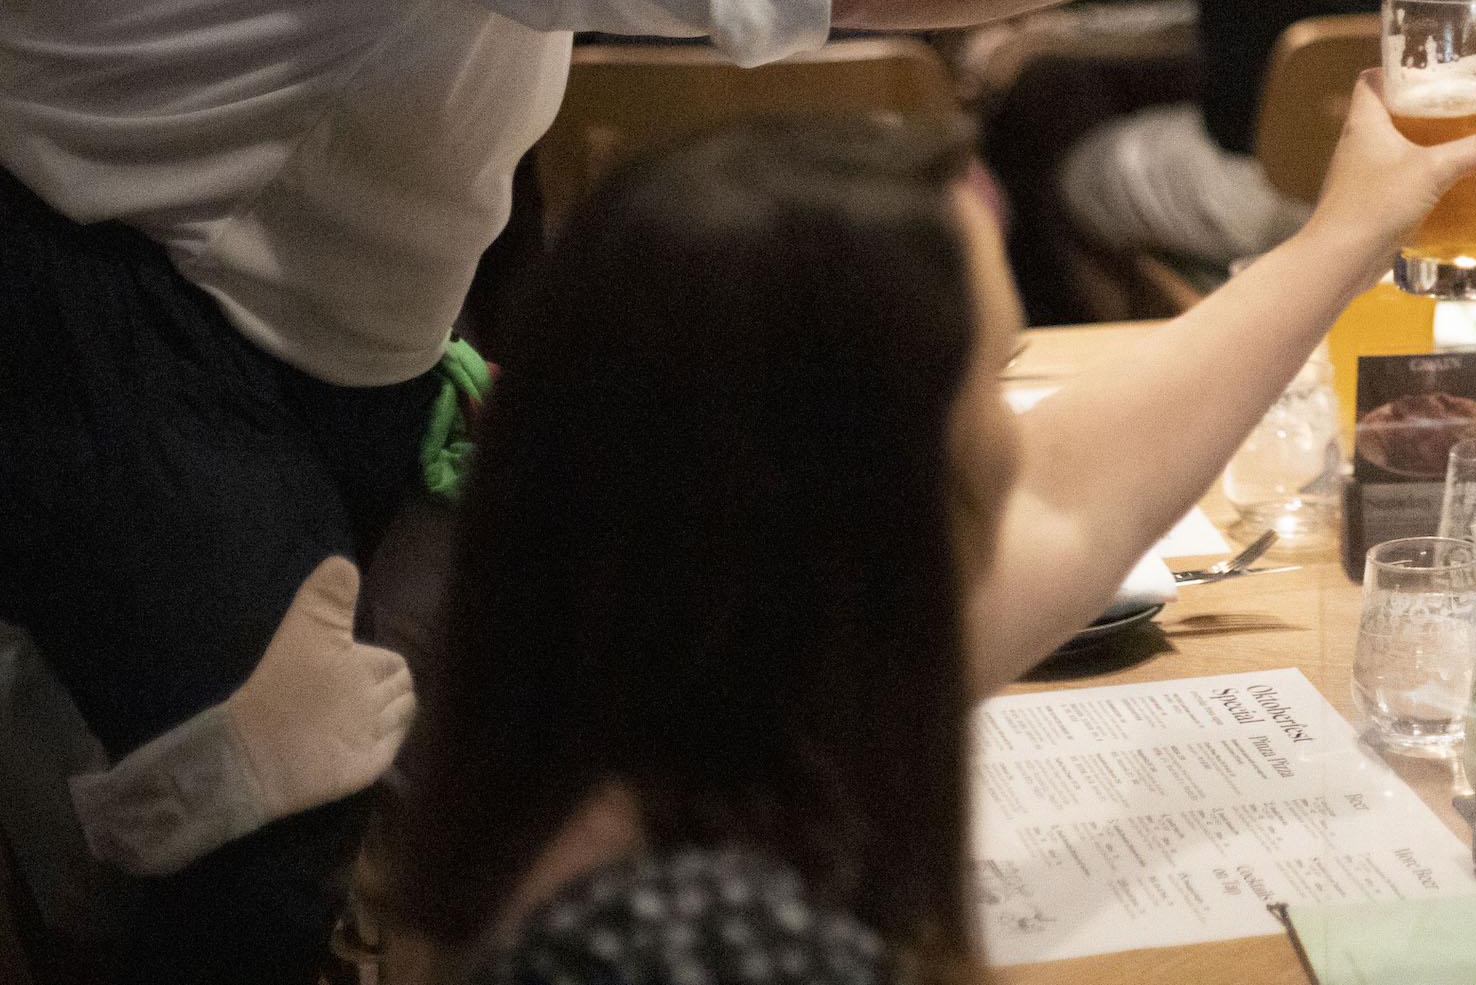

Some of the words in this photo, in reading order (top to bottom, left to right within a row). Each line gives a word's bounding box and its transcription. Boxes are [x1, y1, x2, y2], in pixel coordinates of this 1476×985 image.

[1209, 688, 1265, 725] Special
[1247, 684, 1316, 743] Oktoberfest
[1267, 757, 1295, 778] Pizza
[1344, 793, 1369, 810] Beer
